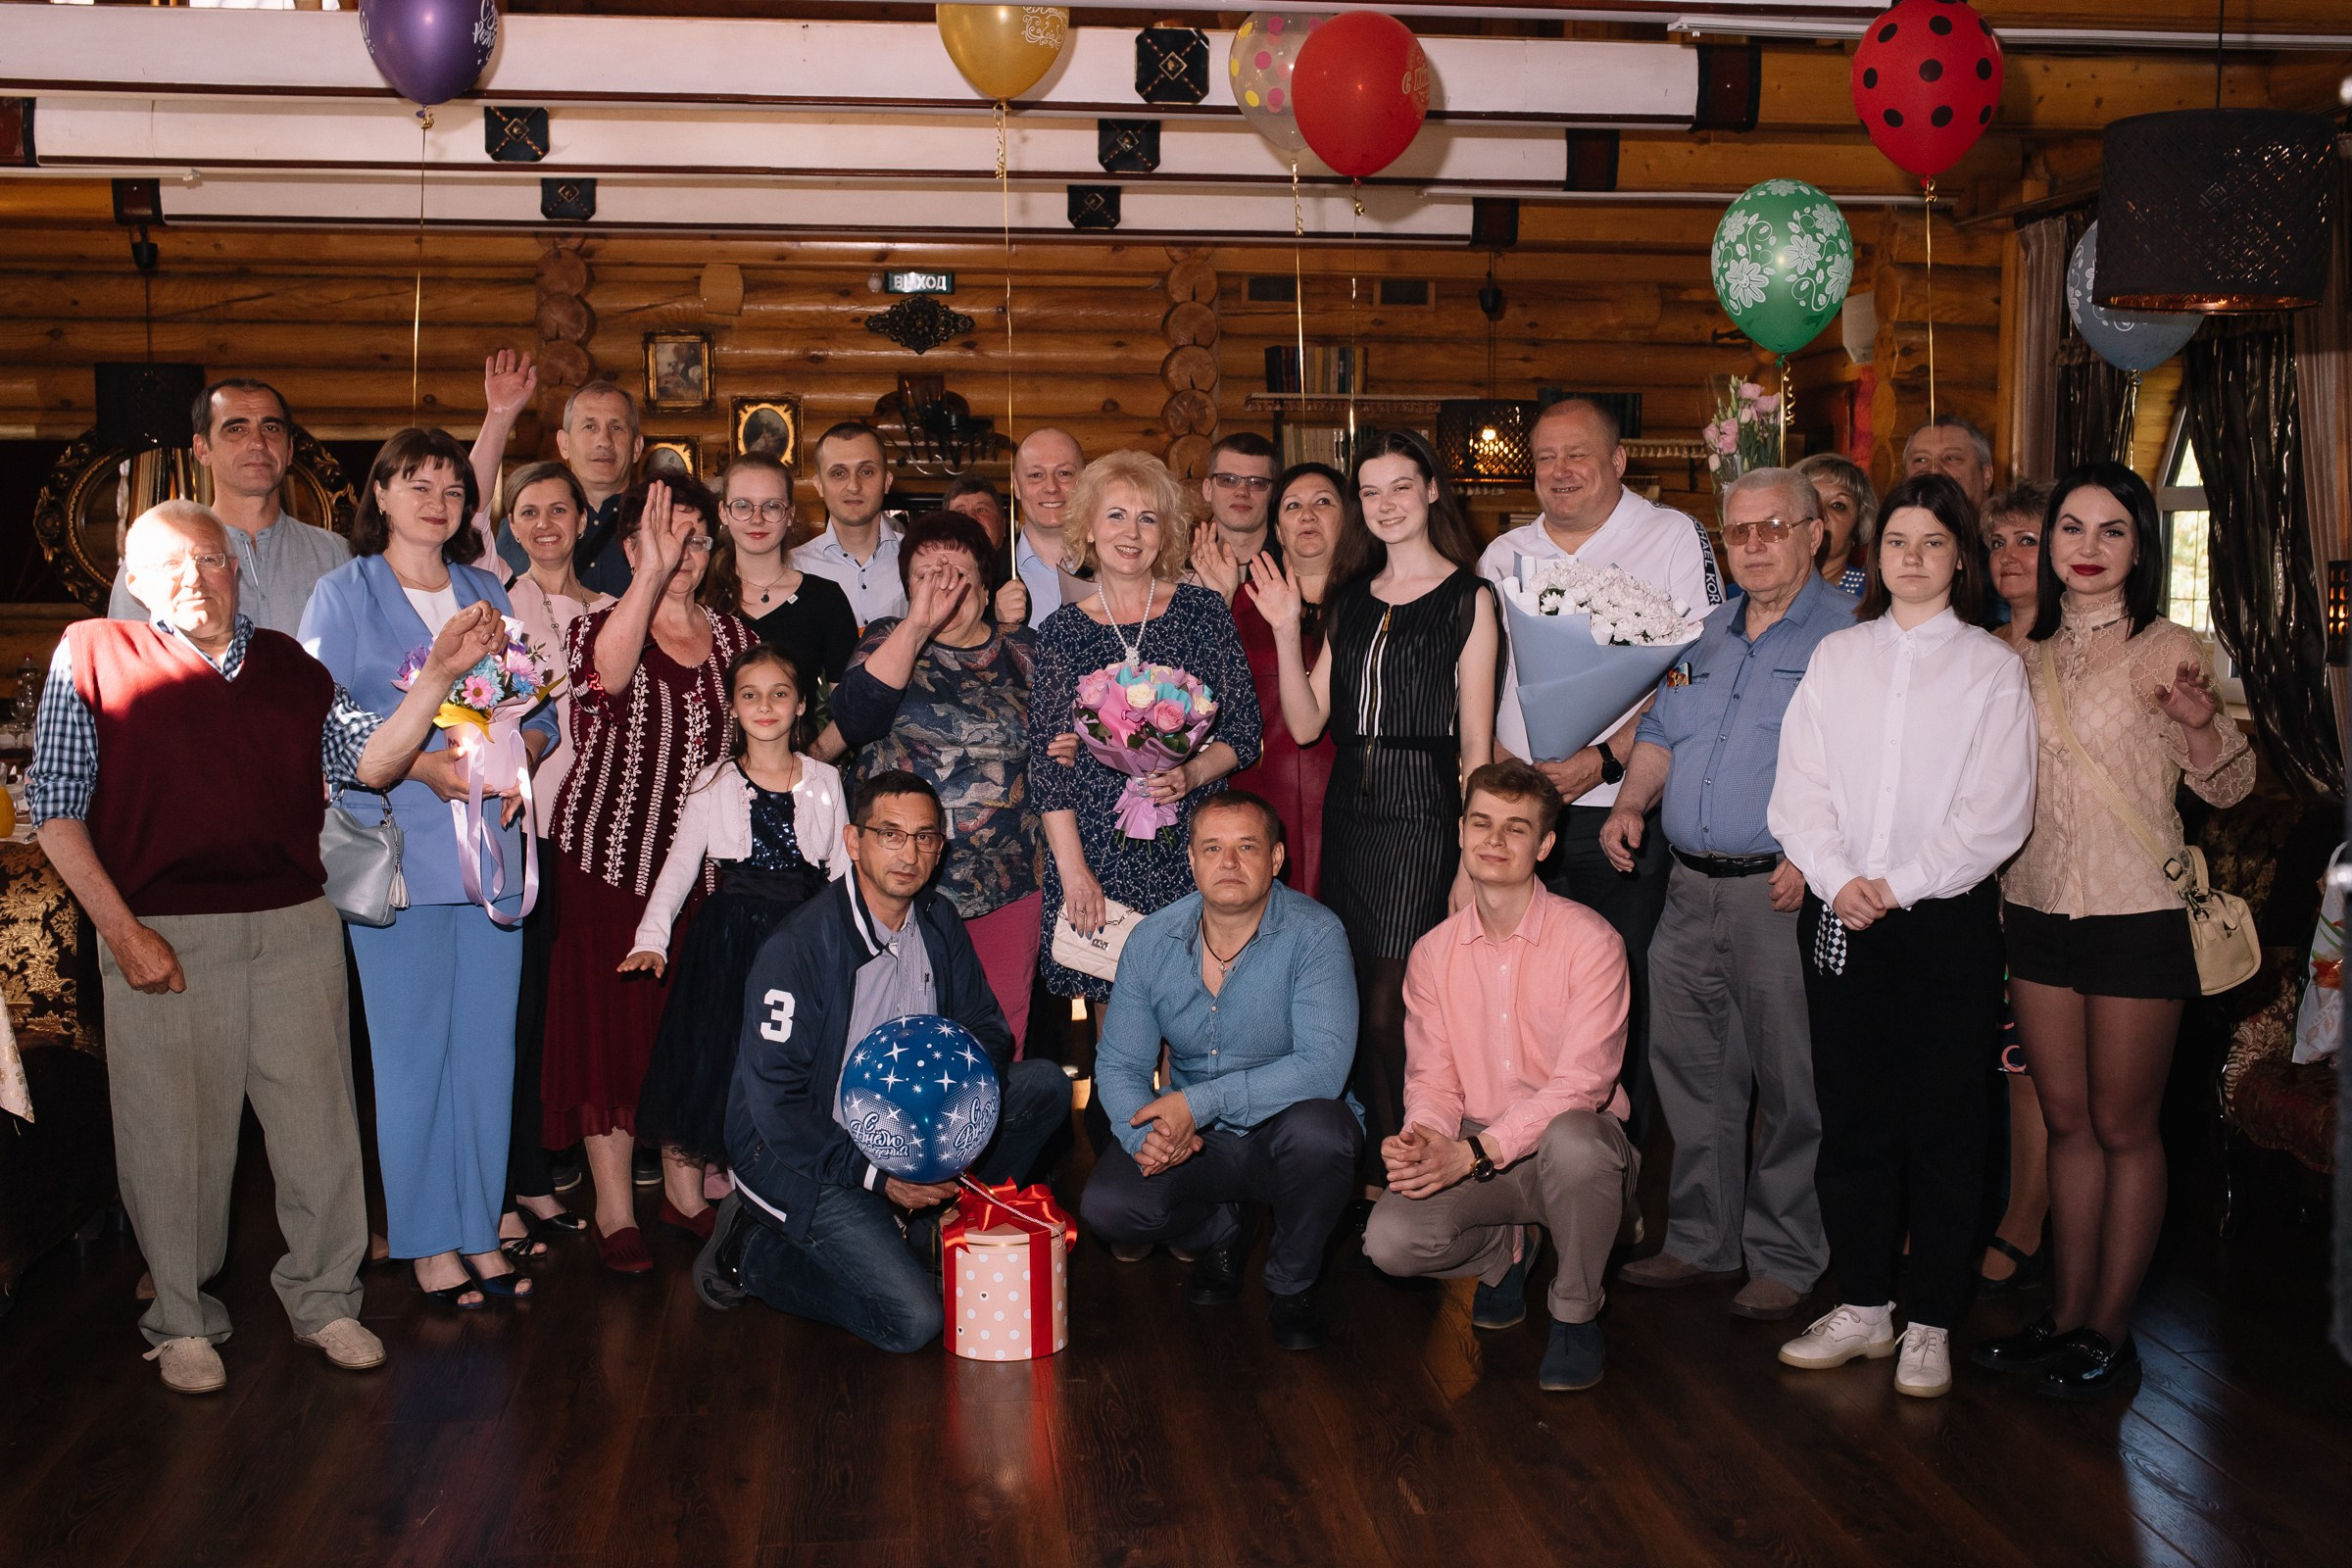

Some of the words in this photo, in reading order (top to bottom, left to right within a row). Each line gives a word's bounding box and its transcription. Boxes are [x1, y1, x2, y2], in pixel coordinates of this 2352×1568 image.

[894, 275, 947, 291] ВЫХОД
[1694, 518, 1714, 567] CHAEL
[1706, 572, 1722, 606] KOR
[760, 989, 795, 1043] 3
[863, 1112, 879, 1131] С
